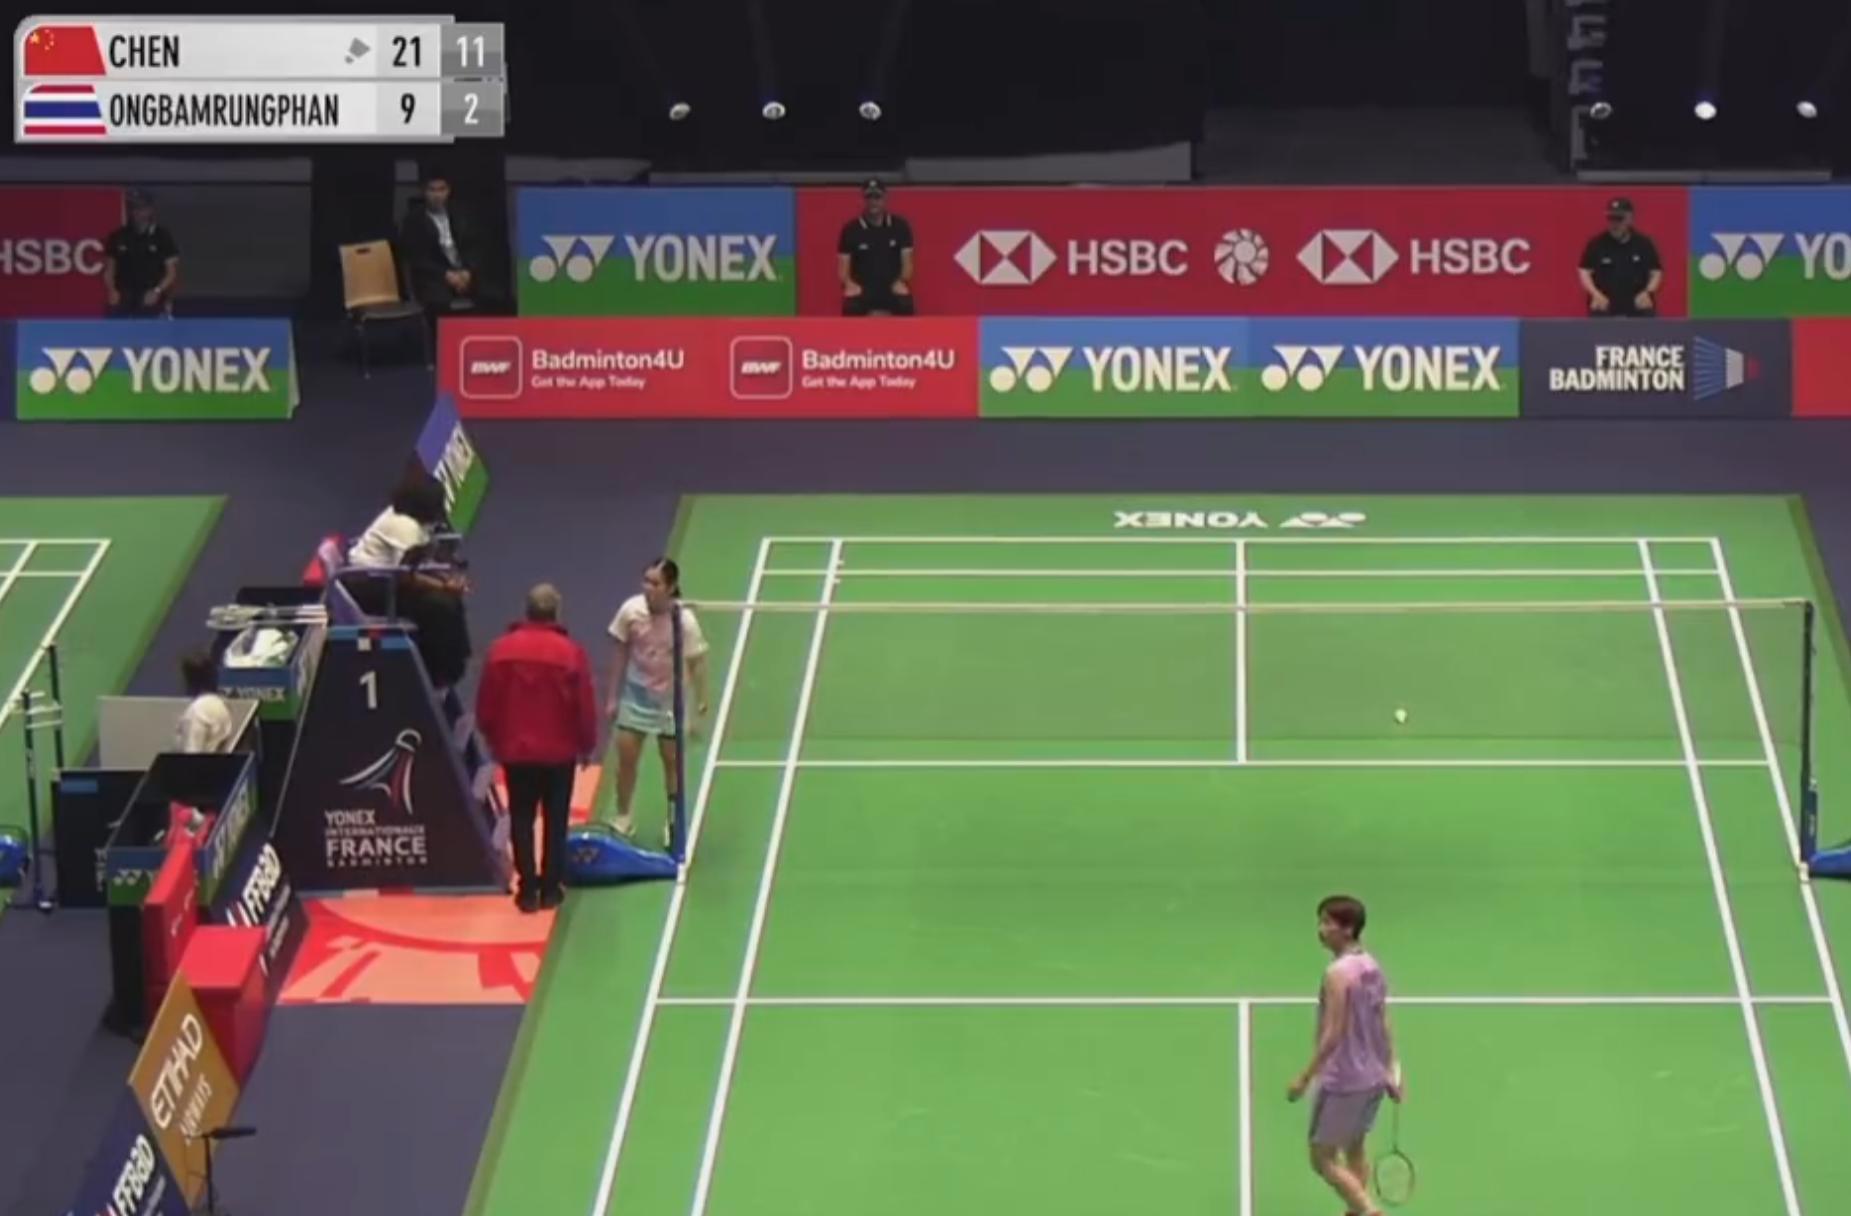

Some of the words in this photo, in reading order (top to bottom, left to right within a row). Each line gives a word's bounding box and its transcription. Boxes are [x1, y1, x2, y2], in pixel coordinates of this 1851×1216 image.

[624, 233, 778, 282] YONEX
[1067, 239, 1189, 276] HSBC
[1410, 238, 1531, 275] HSBC
[532, 349, 684, 370] Badminton4U
[802, 349, 954, 370] Badminton4U
[1352, 345, 1501, 392] YONEX
[1595, 345, 1685, 368] FRANCE
[122, 347, 270, 393] YONEX
[1083, 346, 1232, 392] YONEX
[1549, 367, 1685, 391] BADMINTON
[532, 375, 553, 388] Get
[557, 375, 577, 388] the
[579, 375, 606, 390] App
[609, 375, 646, 390] Today
[802, 375, 823, 388] Get
[827, 375, 847, 388] the
[849, 375, 876, 390] App
[880, 375, 917, 390] Today
[1113, 511, 1269, 529] YONEX
[360, 671, 378, 709] 1
[325, 809, 375, 826] YONEX
[327, 836, 427, 857] FRANCE
[152, 1013, 203, 1130] ETIHAD
